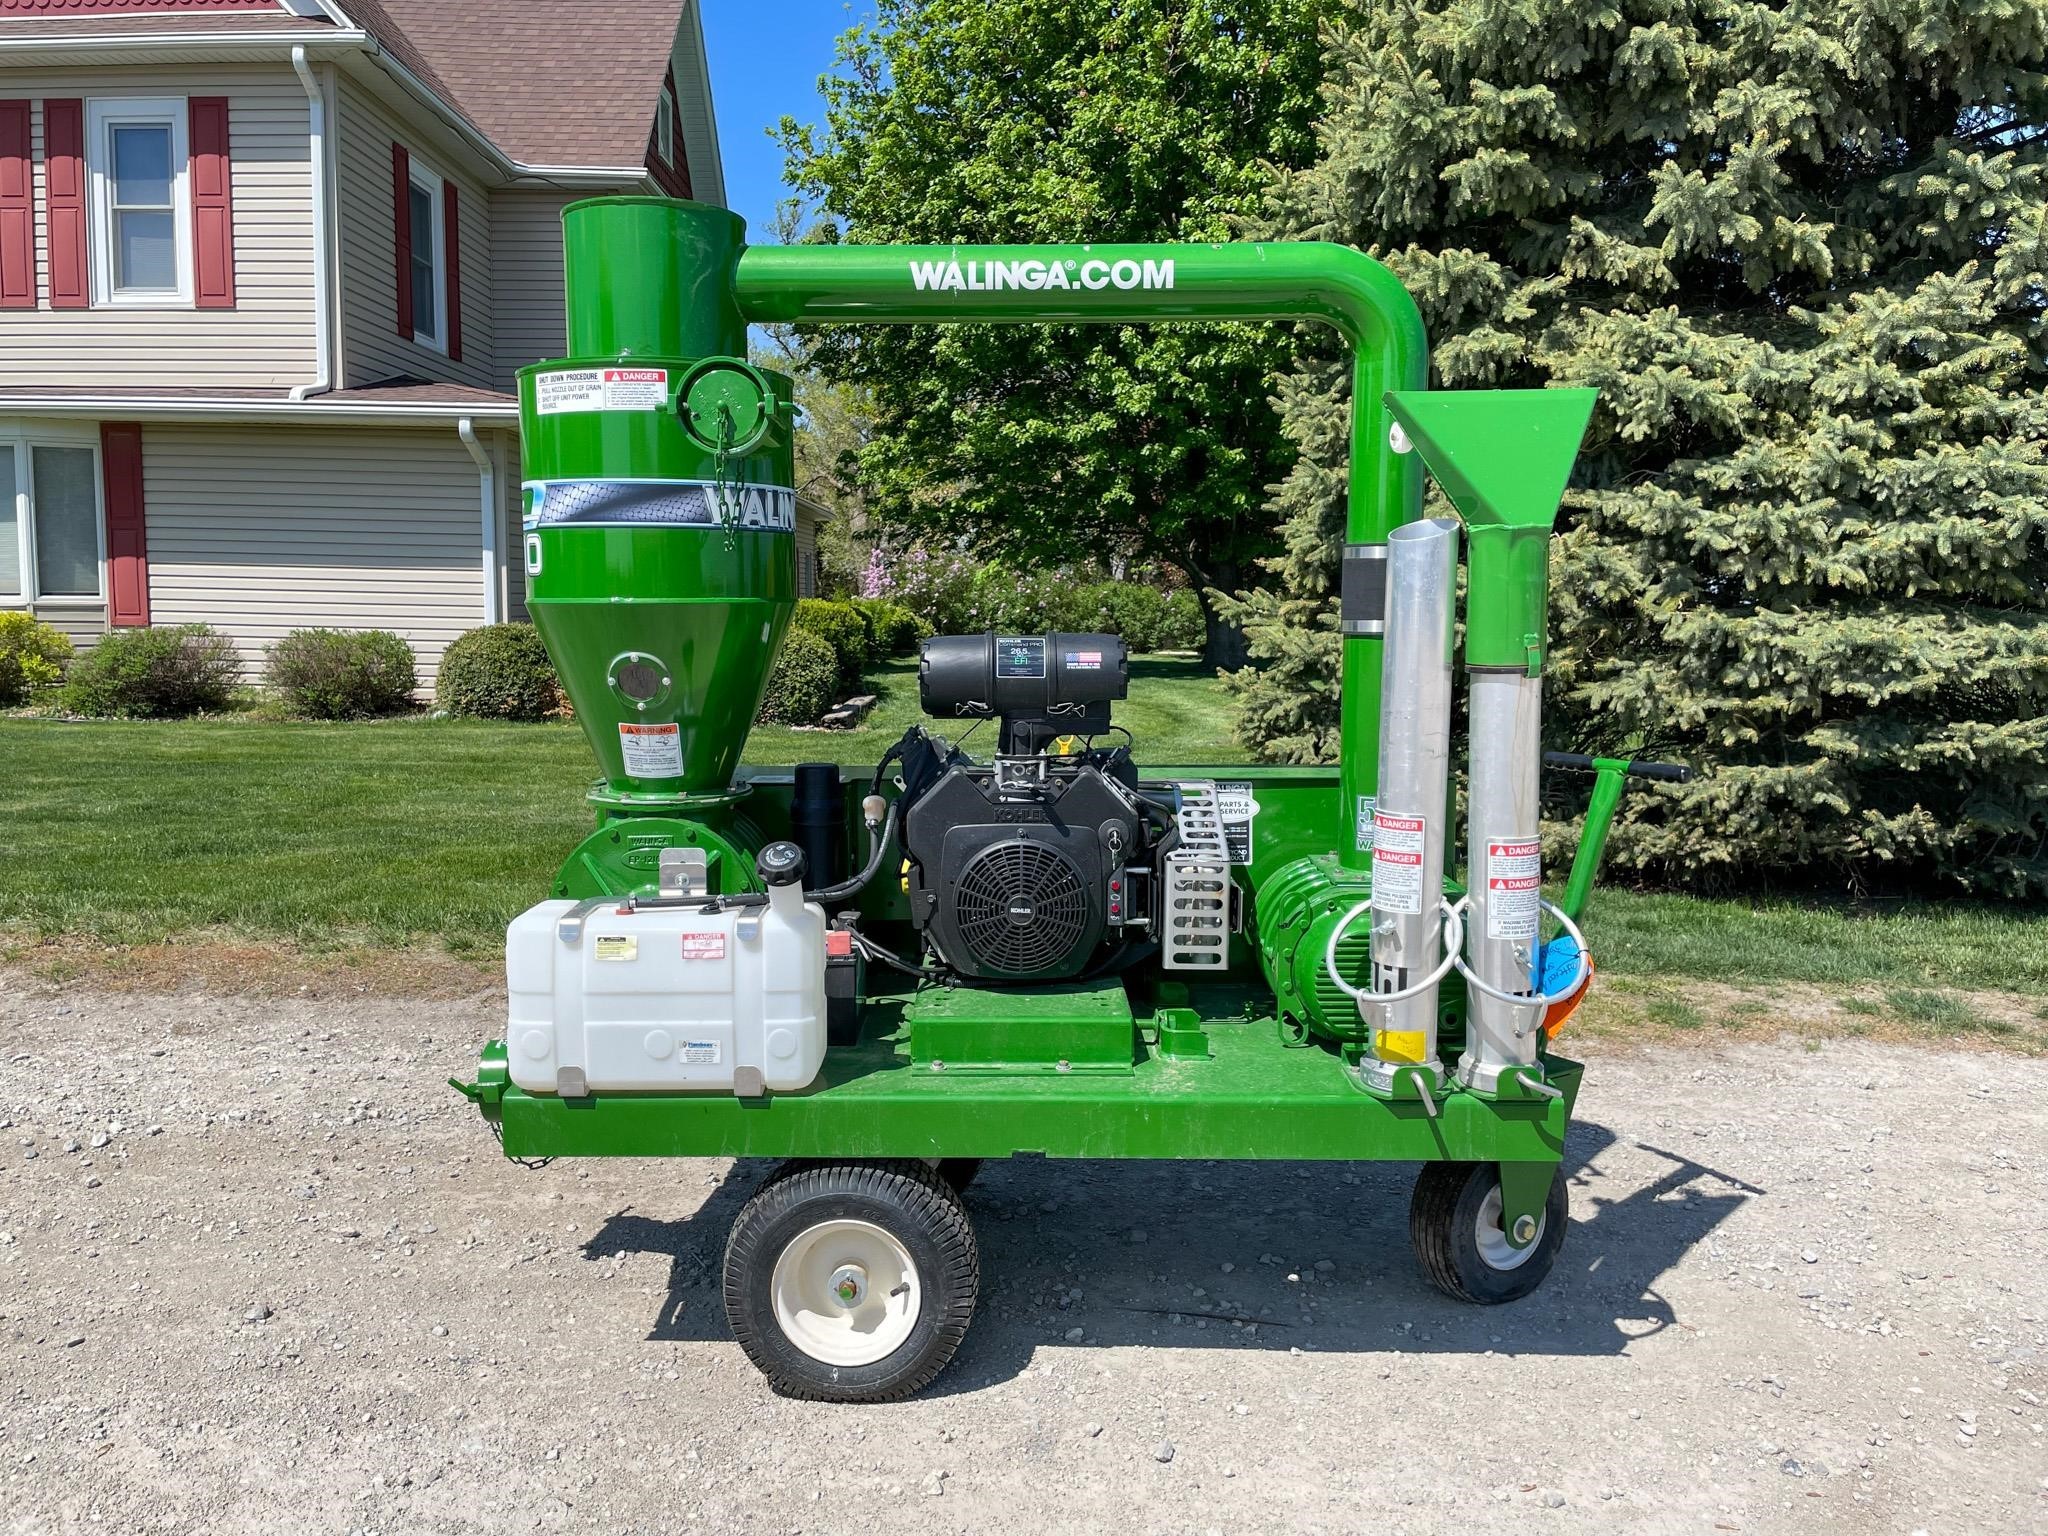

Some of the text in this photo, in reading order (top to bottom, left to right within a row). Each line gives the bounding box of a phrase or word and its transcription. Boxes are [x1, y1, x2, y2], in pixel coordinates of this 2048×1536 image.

[550, 374, 564, 382] DOWN
[566, 372, 598, 381] PROCEDURE
[622, 372, 659, 381] DANGER
[572, 393, 590, 401] POWER
[1014, 657, 1028, 665] EFI
[634, 726, 672, 734] WARNING
[993, 807, 1052, 823] KOHLER
[1382, 819, 1418, 830] DANGER
[631, 837, 669, 846] WALINGA
[1381, 851, 1417, 863] DANGER
